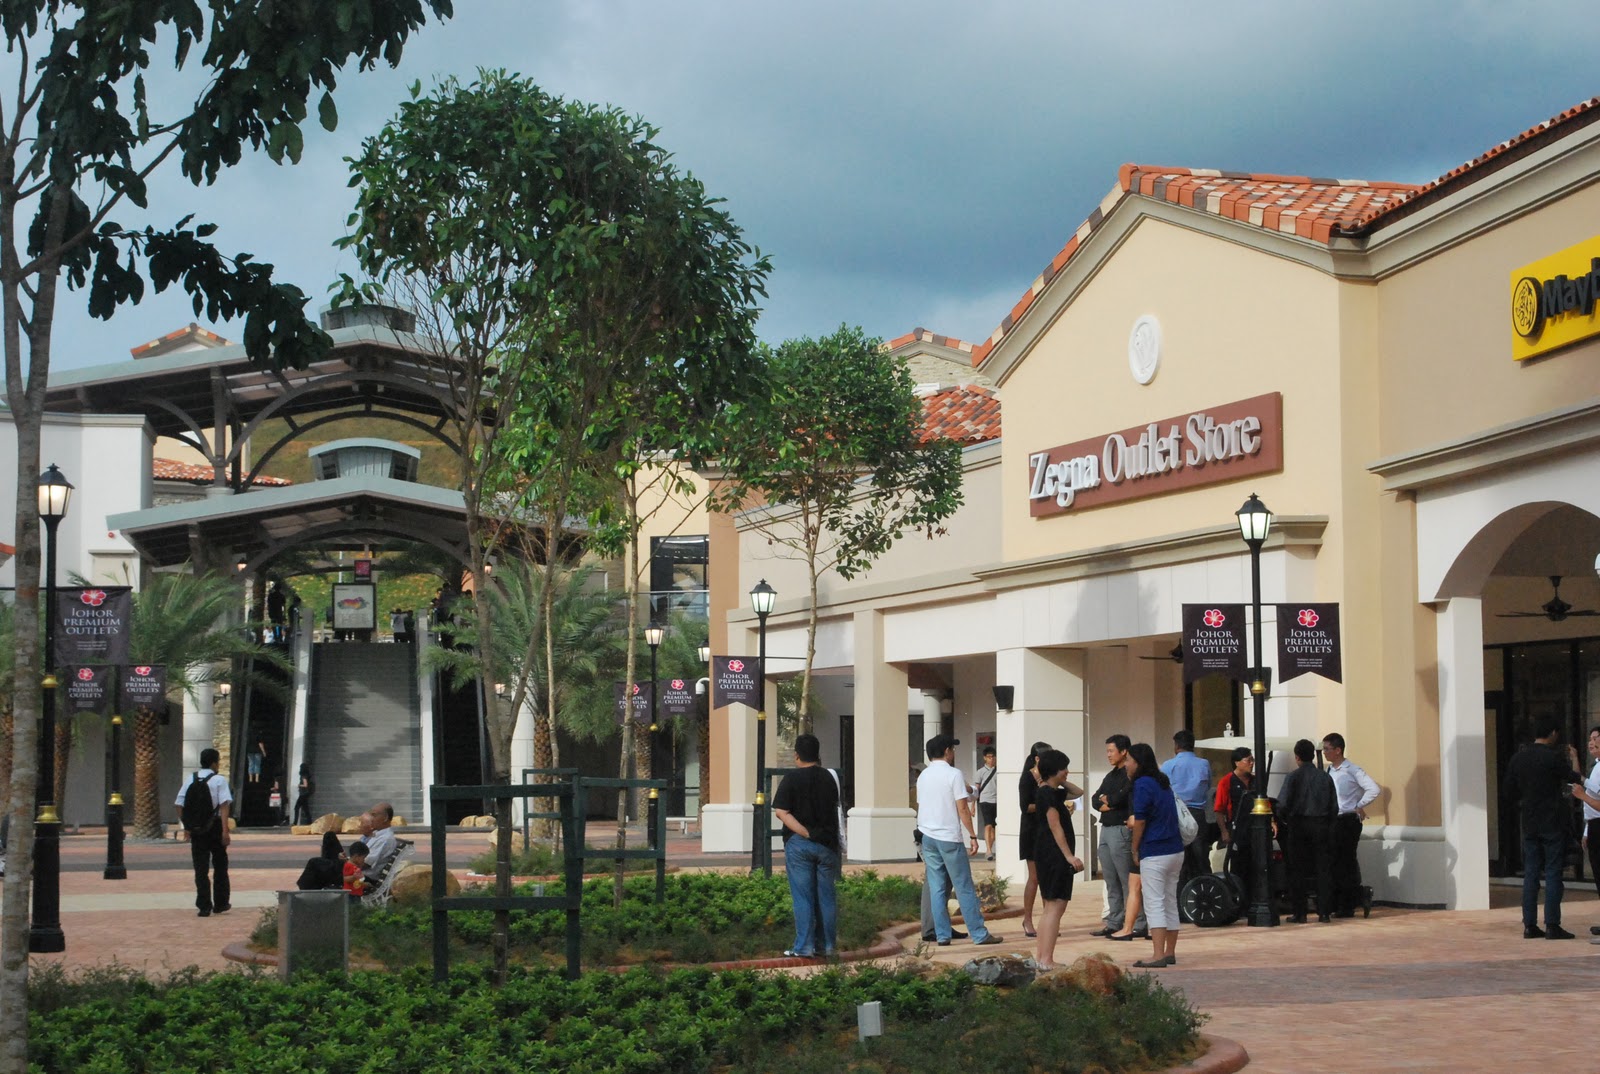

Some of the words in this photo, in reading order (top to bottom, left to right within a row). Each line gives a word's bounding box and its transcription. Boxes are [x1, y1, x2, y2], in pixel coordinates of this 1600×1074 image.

[1029, 452, 1101, 507] Zegna
[1103, 423, 1182, 482] Outlet
[1186, 413, 1261, 466] Store
[72, 607, 114, 617] JOHOR
[63, 618, 120, 626] PREMIUM
[66, 627, 119, 635] OUTLETS
[1196, 629, 1233, 638] JOHOR
[1290, 628, 1327, 638] JOHOR
[1190, 638, 1239, 646] PREMIUM
[1192, 646, 1238, 654] OUTLETS
